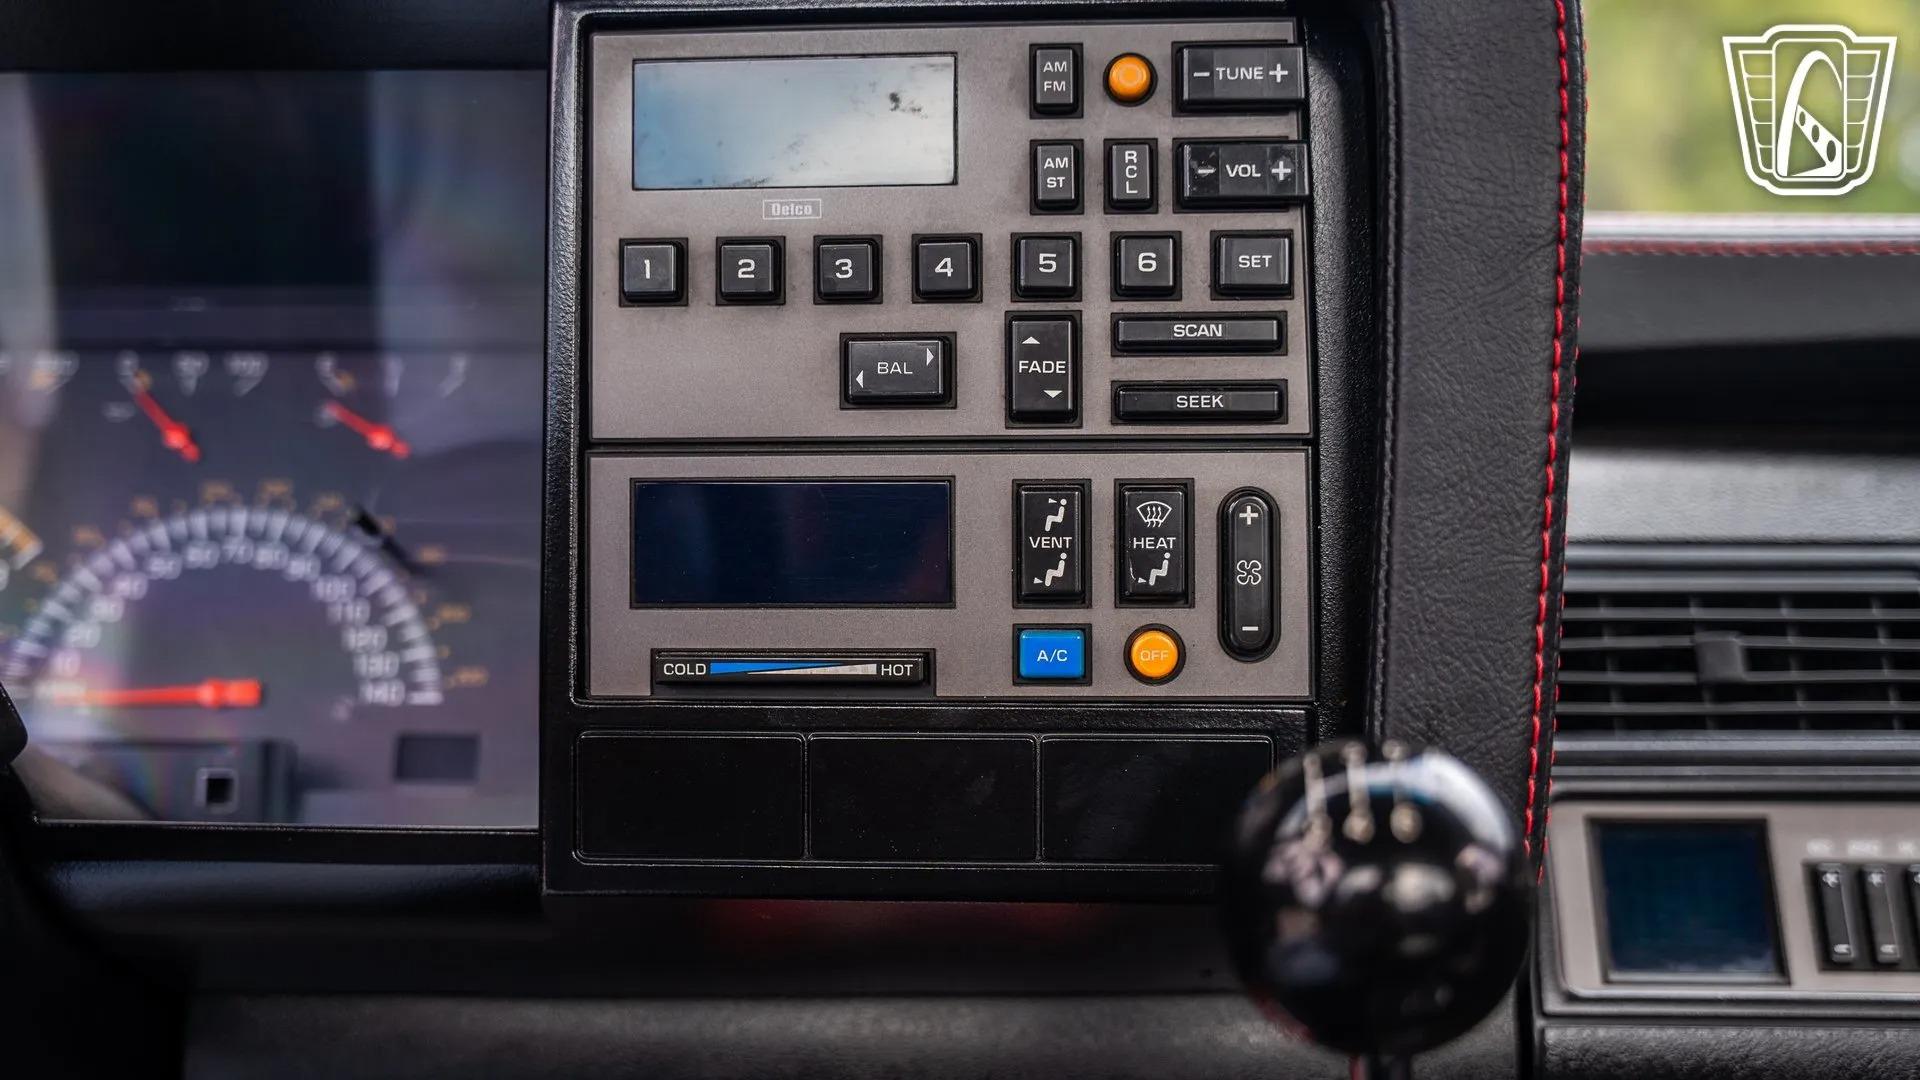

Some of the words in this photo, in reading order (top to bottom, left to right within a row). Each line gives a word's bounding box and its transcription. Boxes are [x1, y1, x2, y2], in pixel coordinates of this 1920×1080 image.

[1043, 61, 1067, 73] AM
[1216, 66, 1264, 80] TUNE
[1043, 81, 1066, 92] FM
[1044, 157, 1069, 169] AM
[1225, 164, 1261, 178] VOL
[1046, 176, 1066, 188] ST
[934, 257, 954, 277] 4
[1038, 253, 1057, 273] 5
[1138, 252, 1157, 272] 6
[1238, 255, 1272, 268] SET
[644, 259, 651, 279] 1
[737, 258, 755, 279] 2
[835, 258, 853, 279] 3
[1173, 324, 1223, 338] SCAN
[877, 361, 913, 375] BAL
[1018, 360, 1066, 374] FADE
[1176, 395, 1224, 408] SEEK
[1029, 536, 1072, 549] VENT
[1133, 537, 1176, 549] HEAT
[1037, 649, 1068, 662] A/C
[1140, 650, 1169, 662] OFF
[663, 663, 707, 676] COLD
[880, 664, 913, 676] HOT
